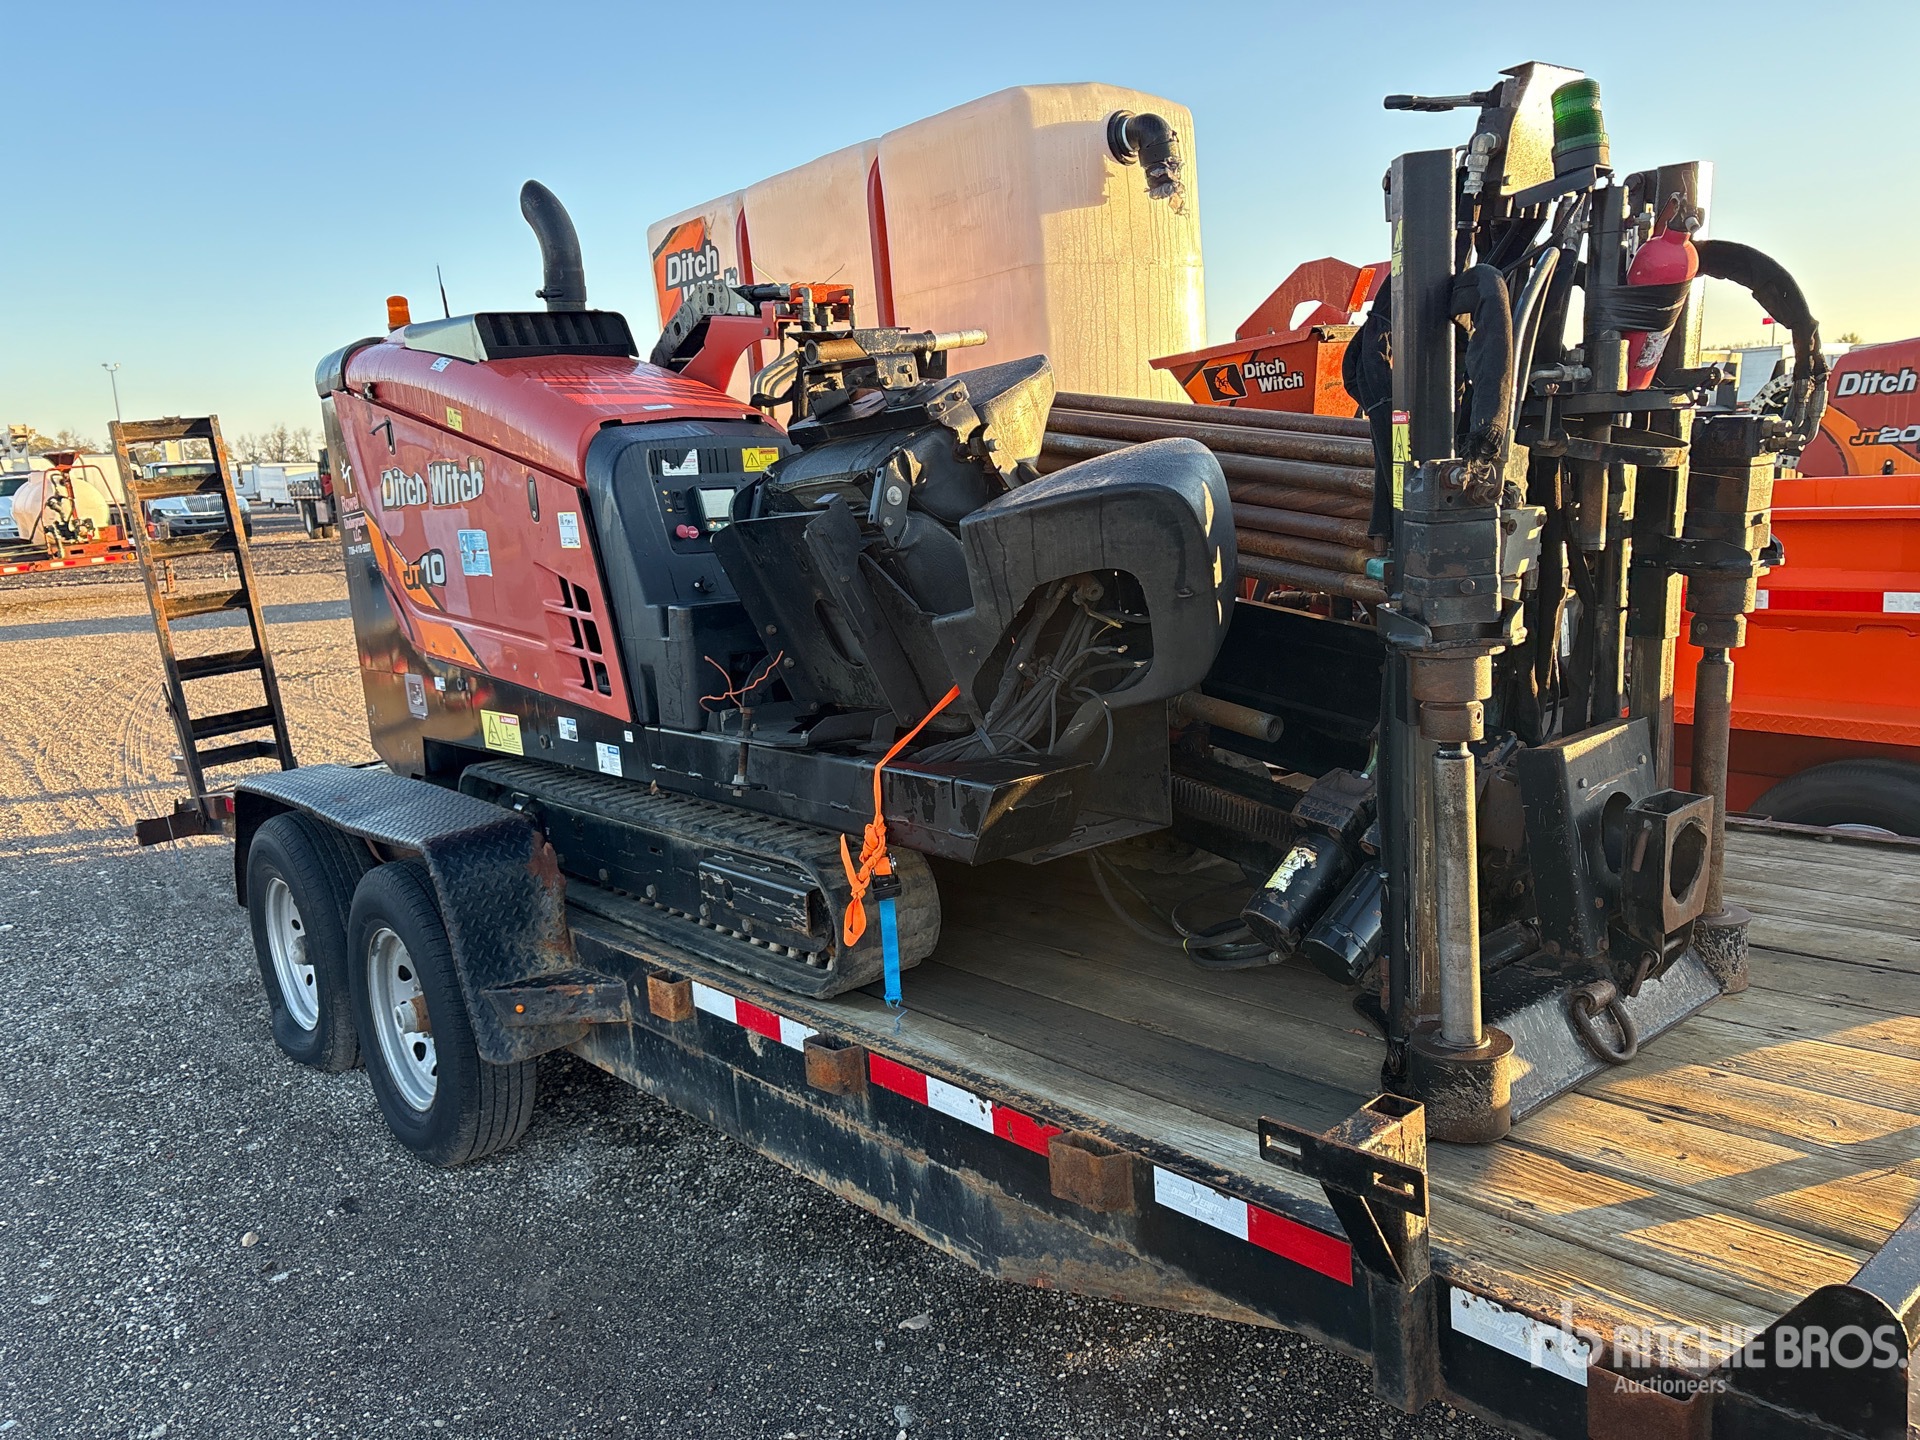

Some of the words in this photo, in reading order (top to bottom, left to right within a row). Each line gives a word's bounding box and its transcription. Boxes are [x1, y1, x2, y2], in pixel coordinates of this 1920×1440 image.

[667, 243, 718, 287] Ditch
[1243, 358, 1285, 379] Ditch
[1257, 372, 1304, 393] Witch
[1837, 368, 1918, 396] Ditch
[1850, 425, 1920, 446] JT20
[381, 467, 429, 507] Ditch
[429, 460, 485, 505] Witch
[403, 552, 447, 588] JT10
